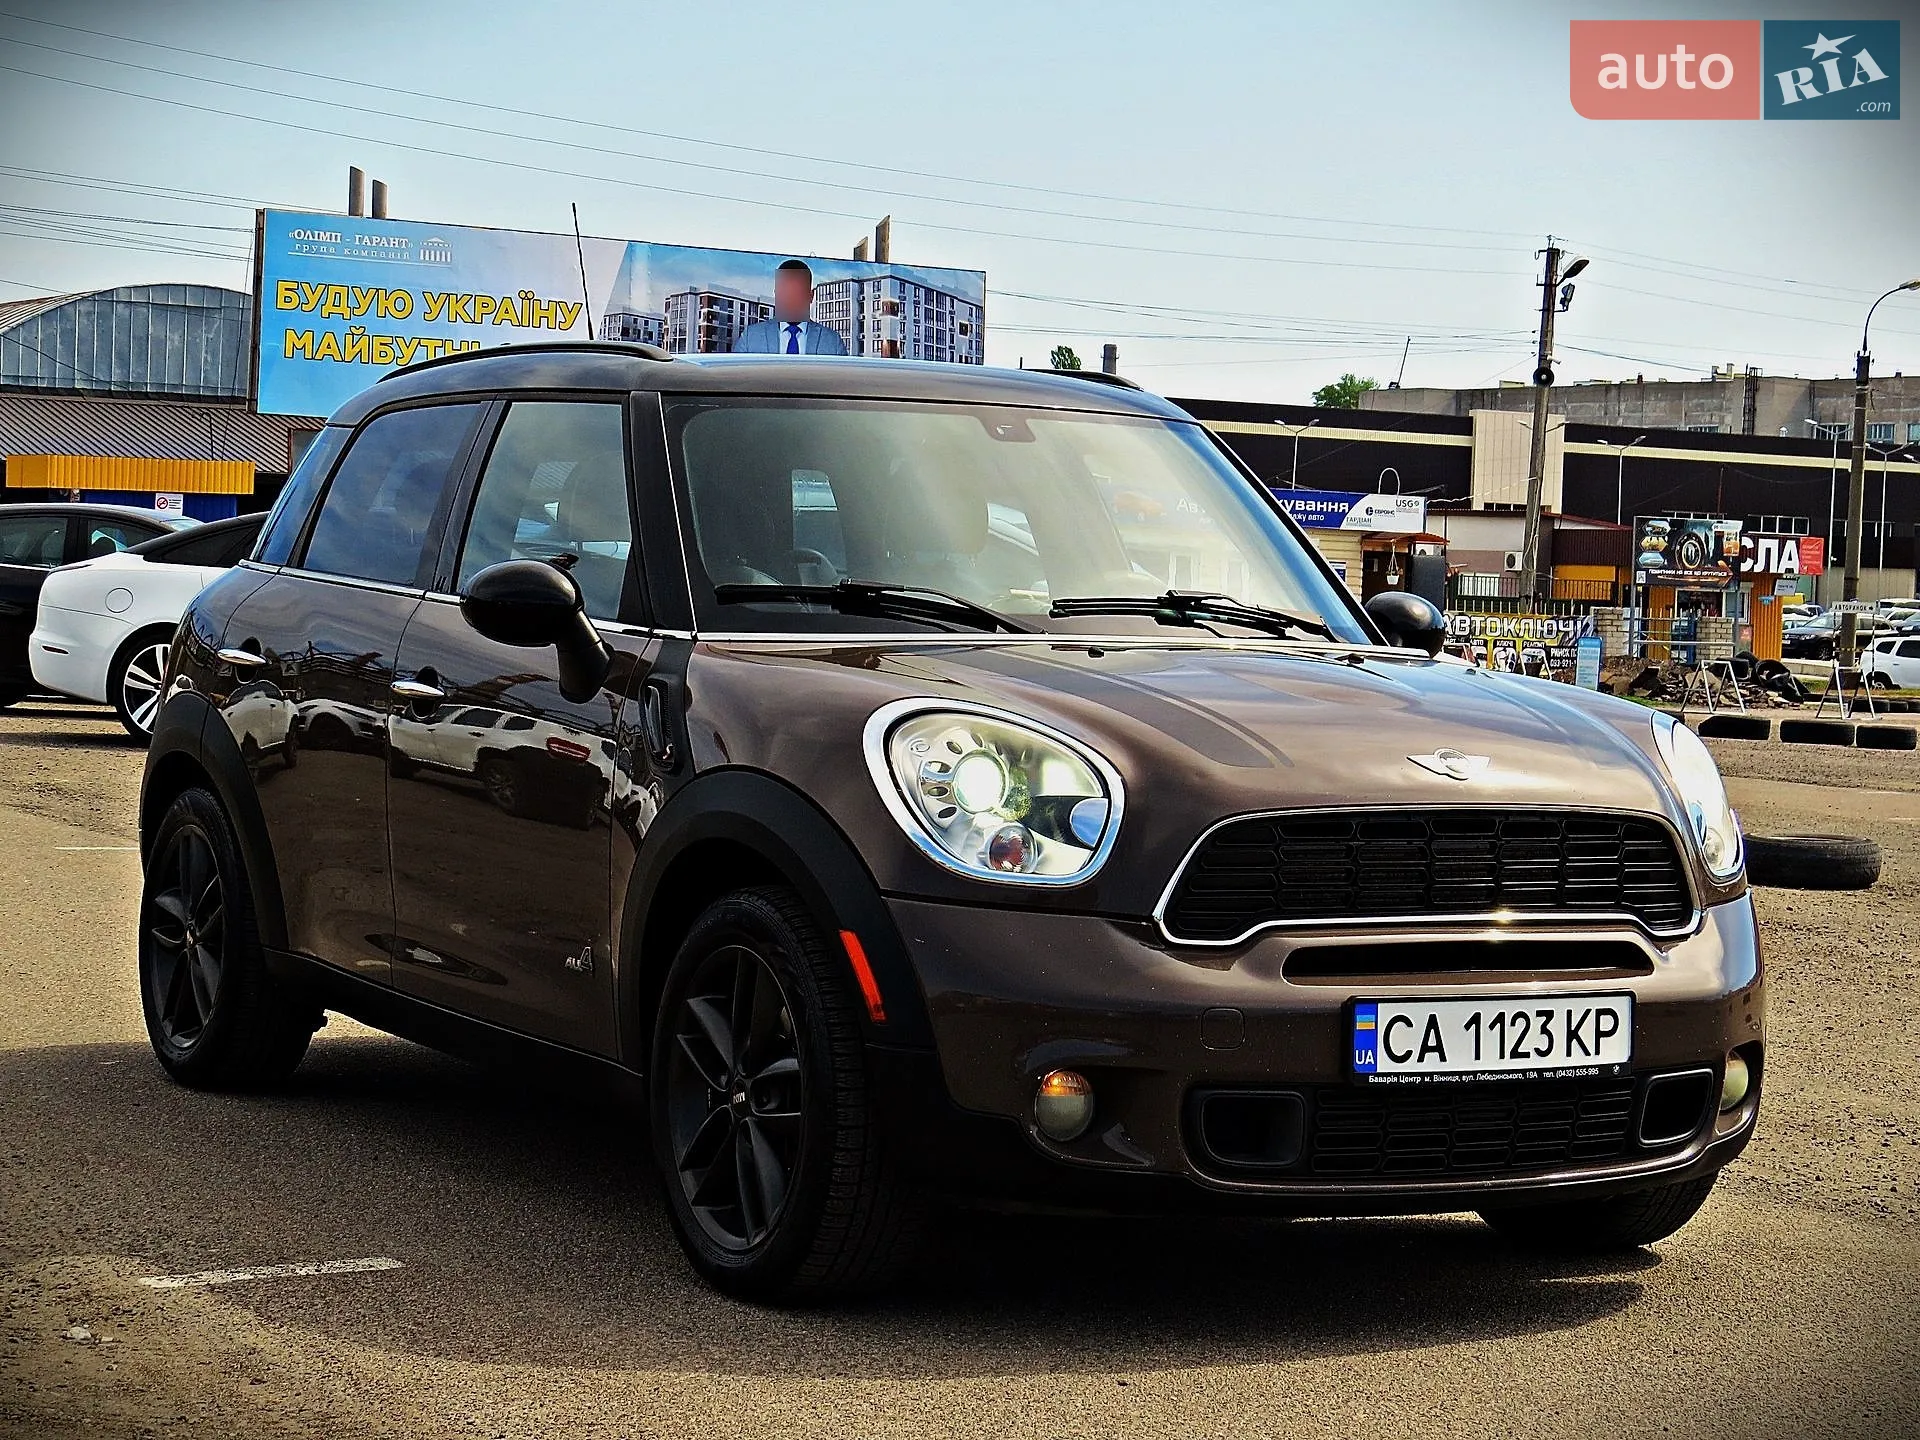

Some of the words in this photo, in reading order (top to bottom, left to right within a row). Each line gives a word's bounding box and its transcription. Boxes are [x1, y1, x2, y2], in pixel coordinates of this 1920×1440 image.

[295, 243, 336, 253] група
[344, 247, 410, 260] компаній
[276, 280, 413, 320] БУДУЮ
[422, 290, 583, 330] УКРАЇНУ
[1395, 499, 1414, 508] USG
[1740, 536, 1800, 574] СЛА
[1382, 1013, 1448, 1064] CA
[1463, 1009, 1555, 1061] 1123
[1565, 1007, 1620, 1058] KP
[1355, 1049, 1375, 1065] UA
[1368, 1075, 1398, 1084] Баварія
[1399, 1075, 1421, 1084] Центр
